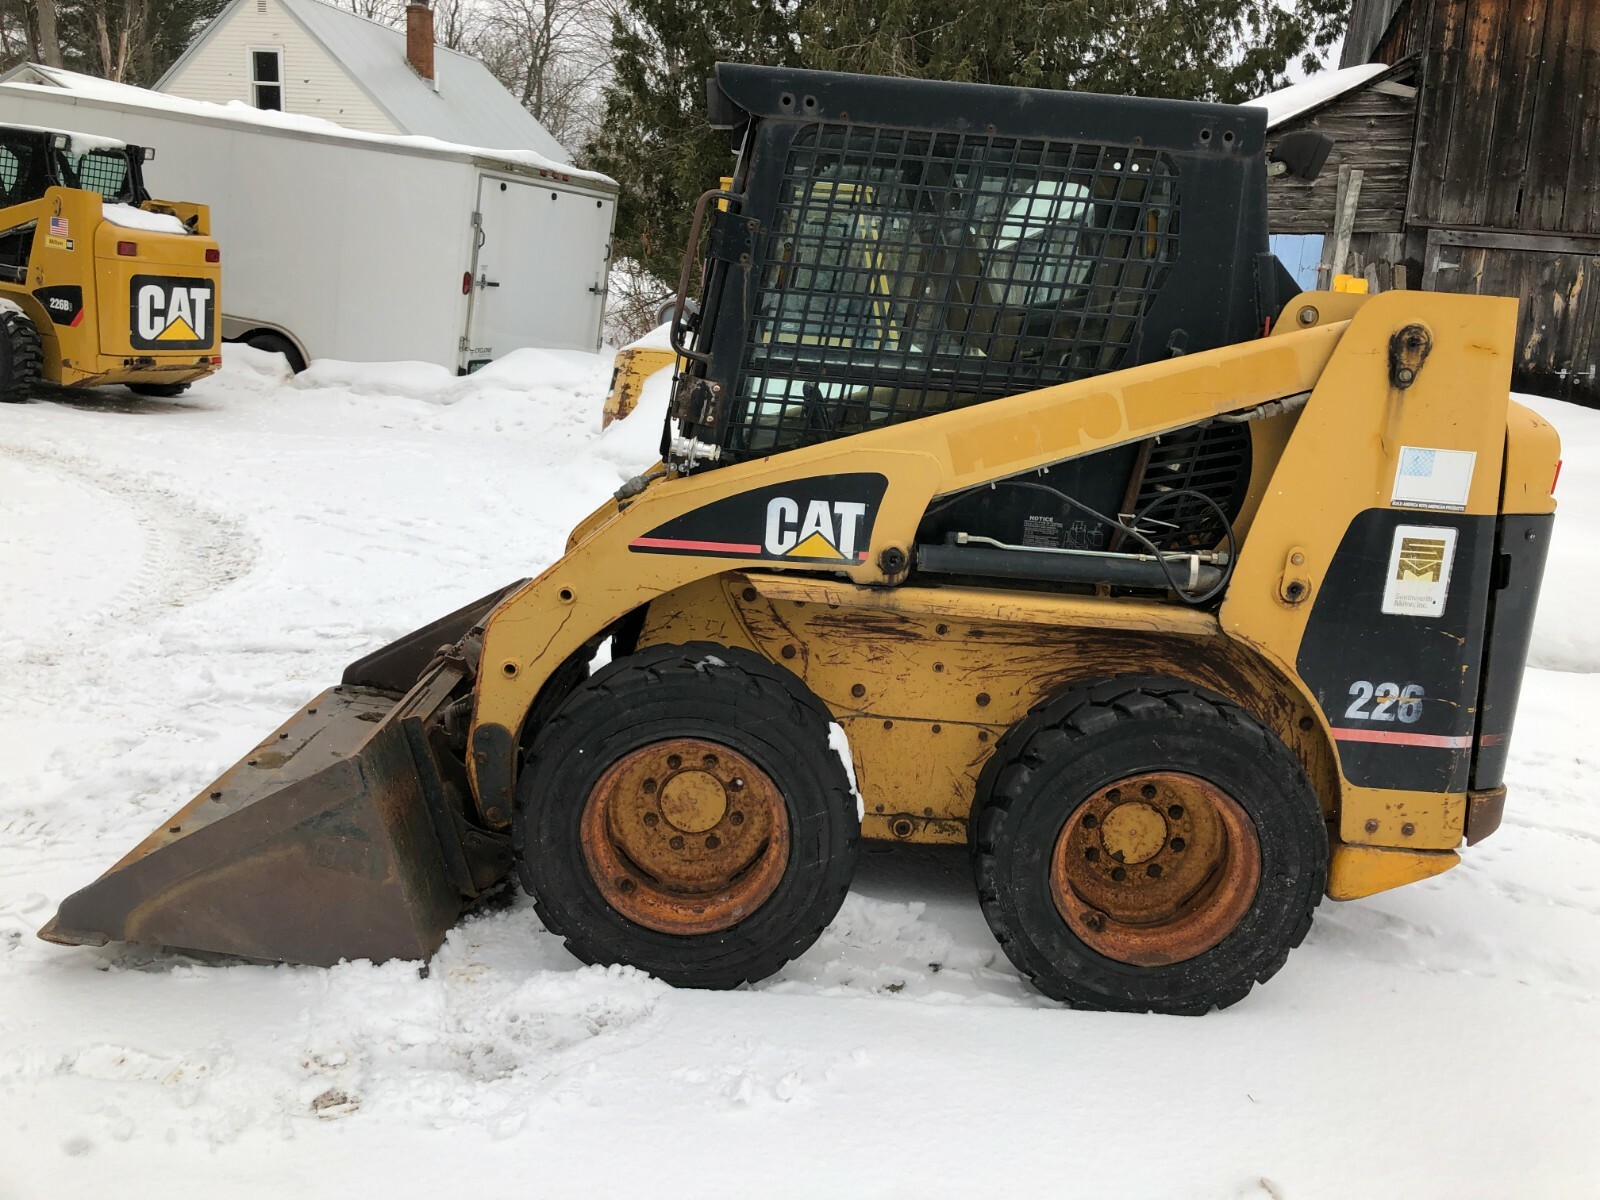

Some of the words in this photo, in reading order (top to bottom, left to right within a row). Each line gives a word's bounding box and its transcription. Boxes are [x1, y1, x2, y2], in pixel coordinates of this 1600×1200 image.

[138, 284, 211, 340] CAT
[765, 496, 866, 560] CAT
[1344, 680, 1425, 723] 226
